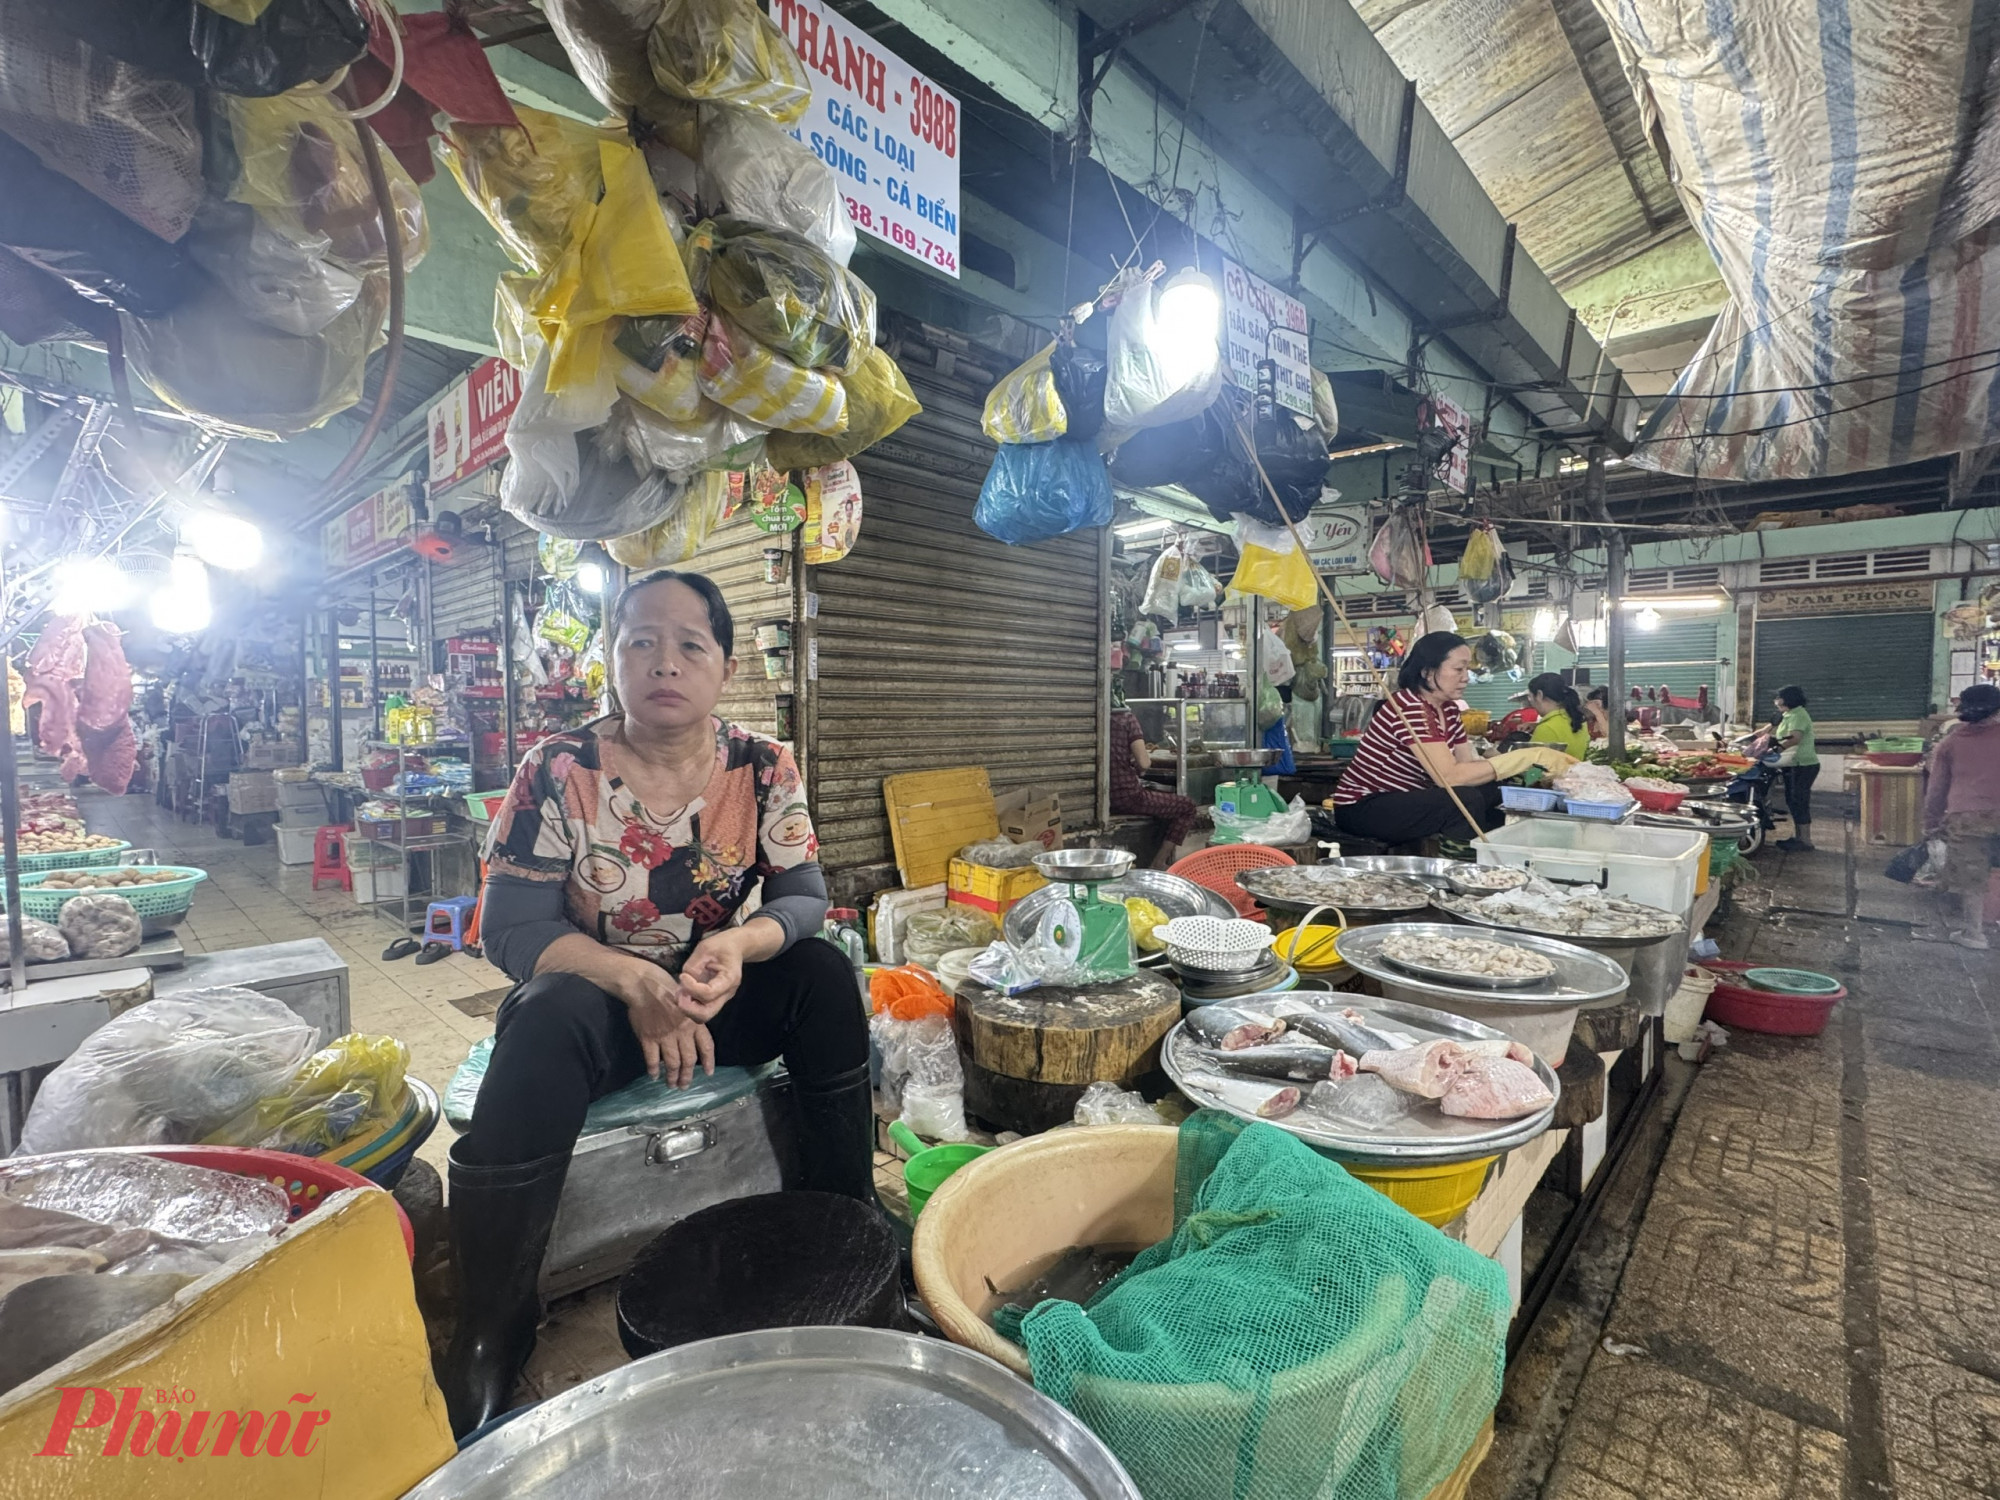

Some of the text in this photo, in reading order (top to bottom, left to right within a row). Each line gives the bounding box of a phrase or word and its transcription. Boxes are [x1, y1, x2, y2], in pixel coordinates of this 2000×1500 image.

[774, 0, 887, 114] THANH
[909, 76, 956, 159] 398B
[827, 98, 915, 173] CÁC LOẠI
[810, 131, 867, 185] SÔNG
[886, 176, 911, 211] CÁ
[917, 193, 956, 236] BIỂN
[838, 191, 956, 272] 38.169.734
[1226, 268, 1244, 302] CÔ
[1246, 284, 1276, 320] CHÍN
[1228, 308, 1246, 335] HẢI
[1229, 340, 1250, 368] THỊT
[1295, 368, 1312, 399] GHẸ
[1323, 521, 1352, 542] Yến
[1787, 594, 1834, 606] NAM
[1843, 588, 1920, 602] PHONG
